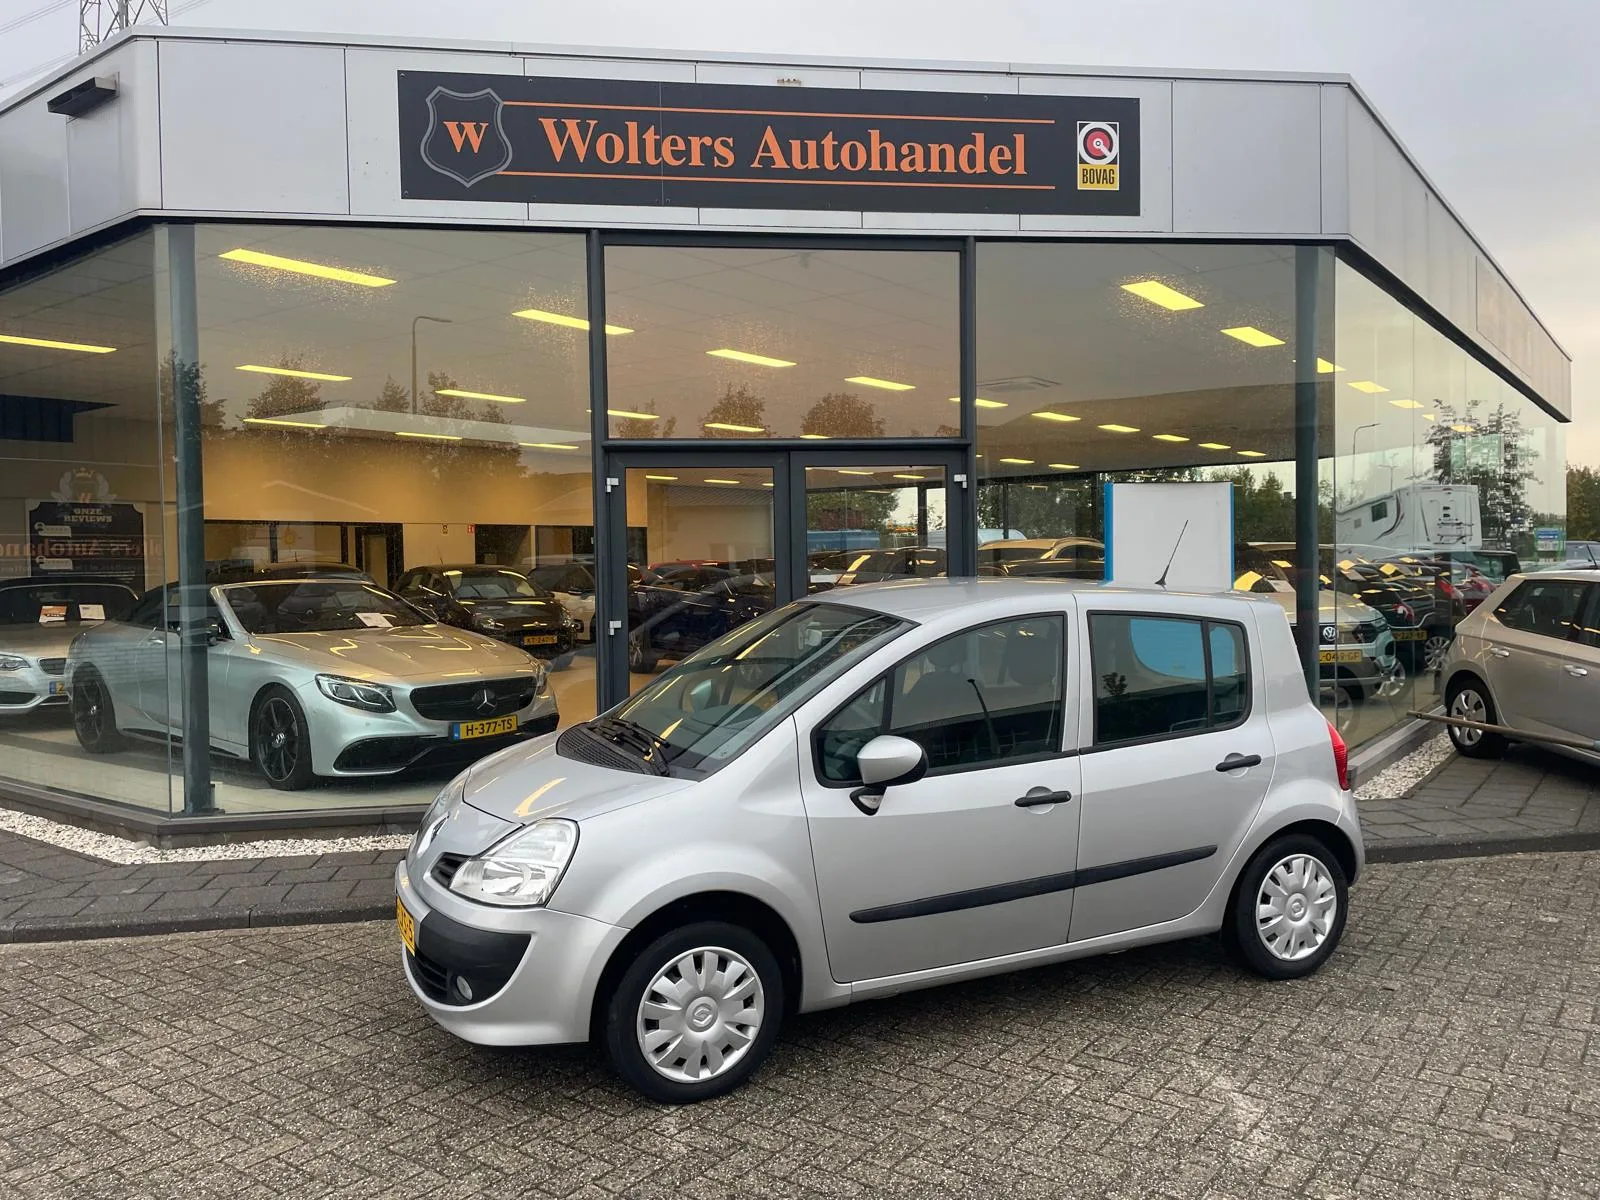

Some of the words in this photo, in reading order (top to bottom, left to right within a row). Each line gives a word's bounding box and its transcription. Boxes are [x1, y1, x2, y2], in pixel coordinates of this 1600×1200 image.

[443, 121, 489, 153] W
[538, 117, 735, 168] Wolters
[750, 125, 1028, 175] Autohandel
[1082, 168, 1115, 185] BOVAG
[63, 515, 113, 523] REVIEWS
[73, 507, 102, 515] ONZE
[466, 718, 512, 736] H-377-TS
